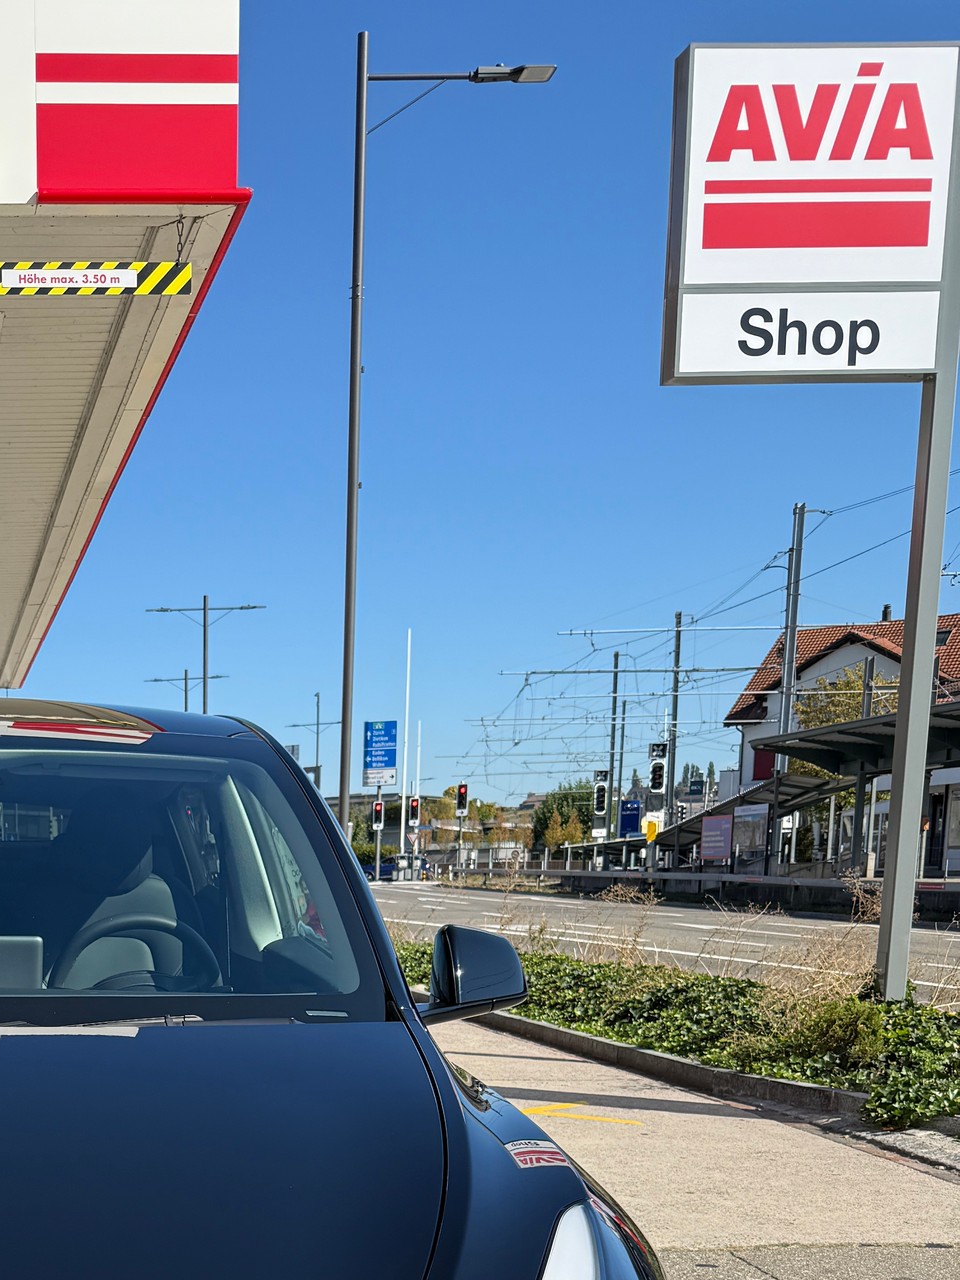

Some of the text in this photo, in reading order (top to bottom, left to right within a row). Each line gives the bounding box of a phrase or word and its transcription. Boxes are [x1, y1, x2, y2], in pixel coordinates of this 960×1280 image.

[706, 62, 934, 162] AVIA
[18, 274, 120, 284] Höhe max. 3.50 m
[738, 308, 880, 366] Shop
